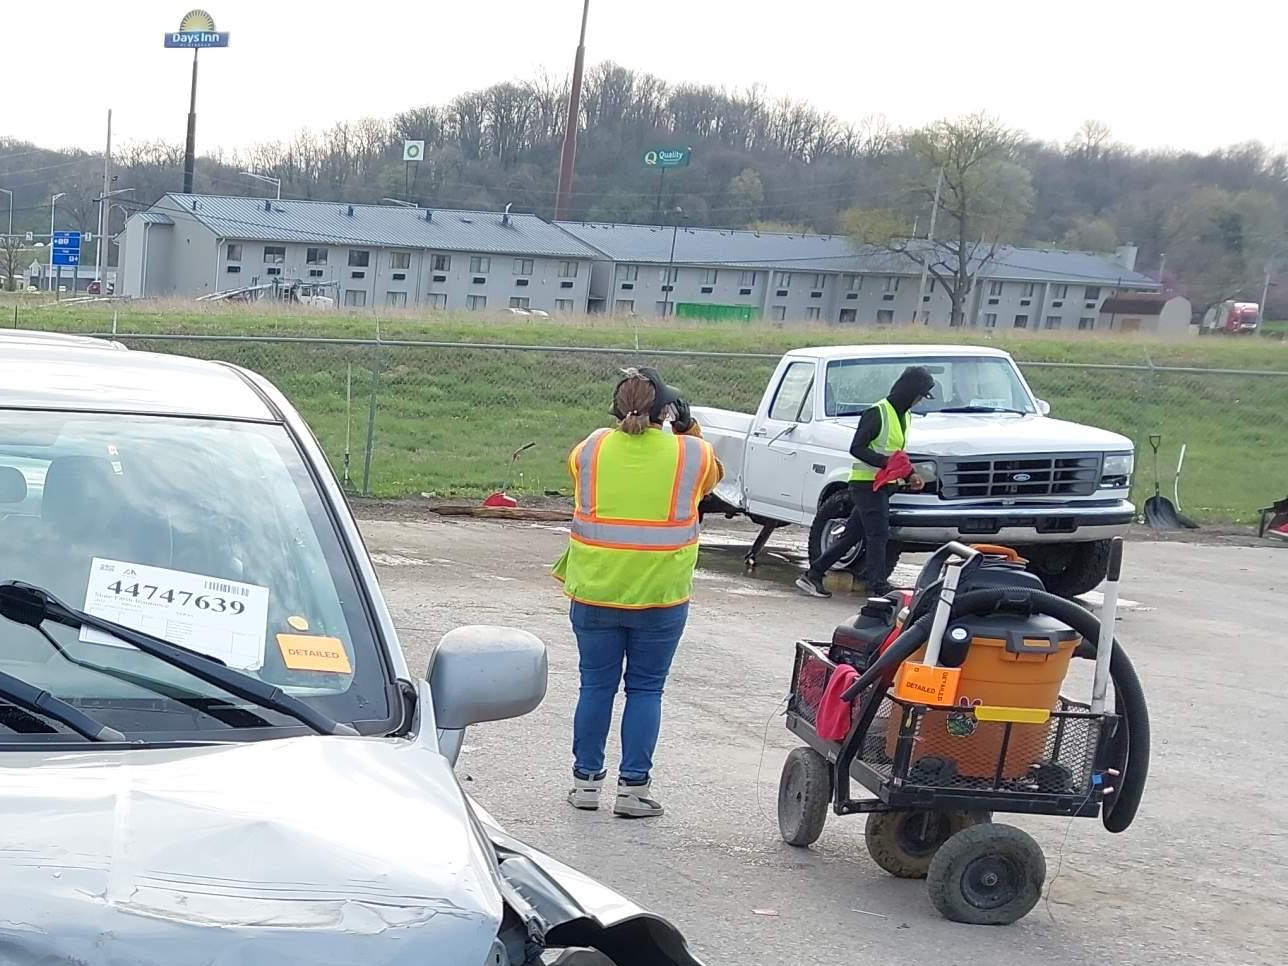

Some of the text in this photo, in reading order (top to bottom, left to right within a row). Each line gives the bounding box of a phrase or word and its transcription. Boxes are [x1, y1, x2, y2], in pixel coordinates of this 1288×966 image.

[172, 32, 220, 43] Days Inn
[659, 151, 684, 161] Quality
[107, 580, 246, 615] 44747639
[288, 648, 340, 659] DETAILED
[906, 681, 936, 694] DETAILED
